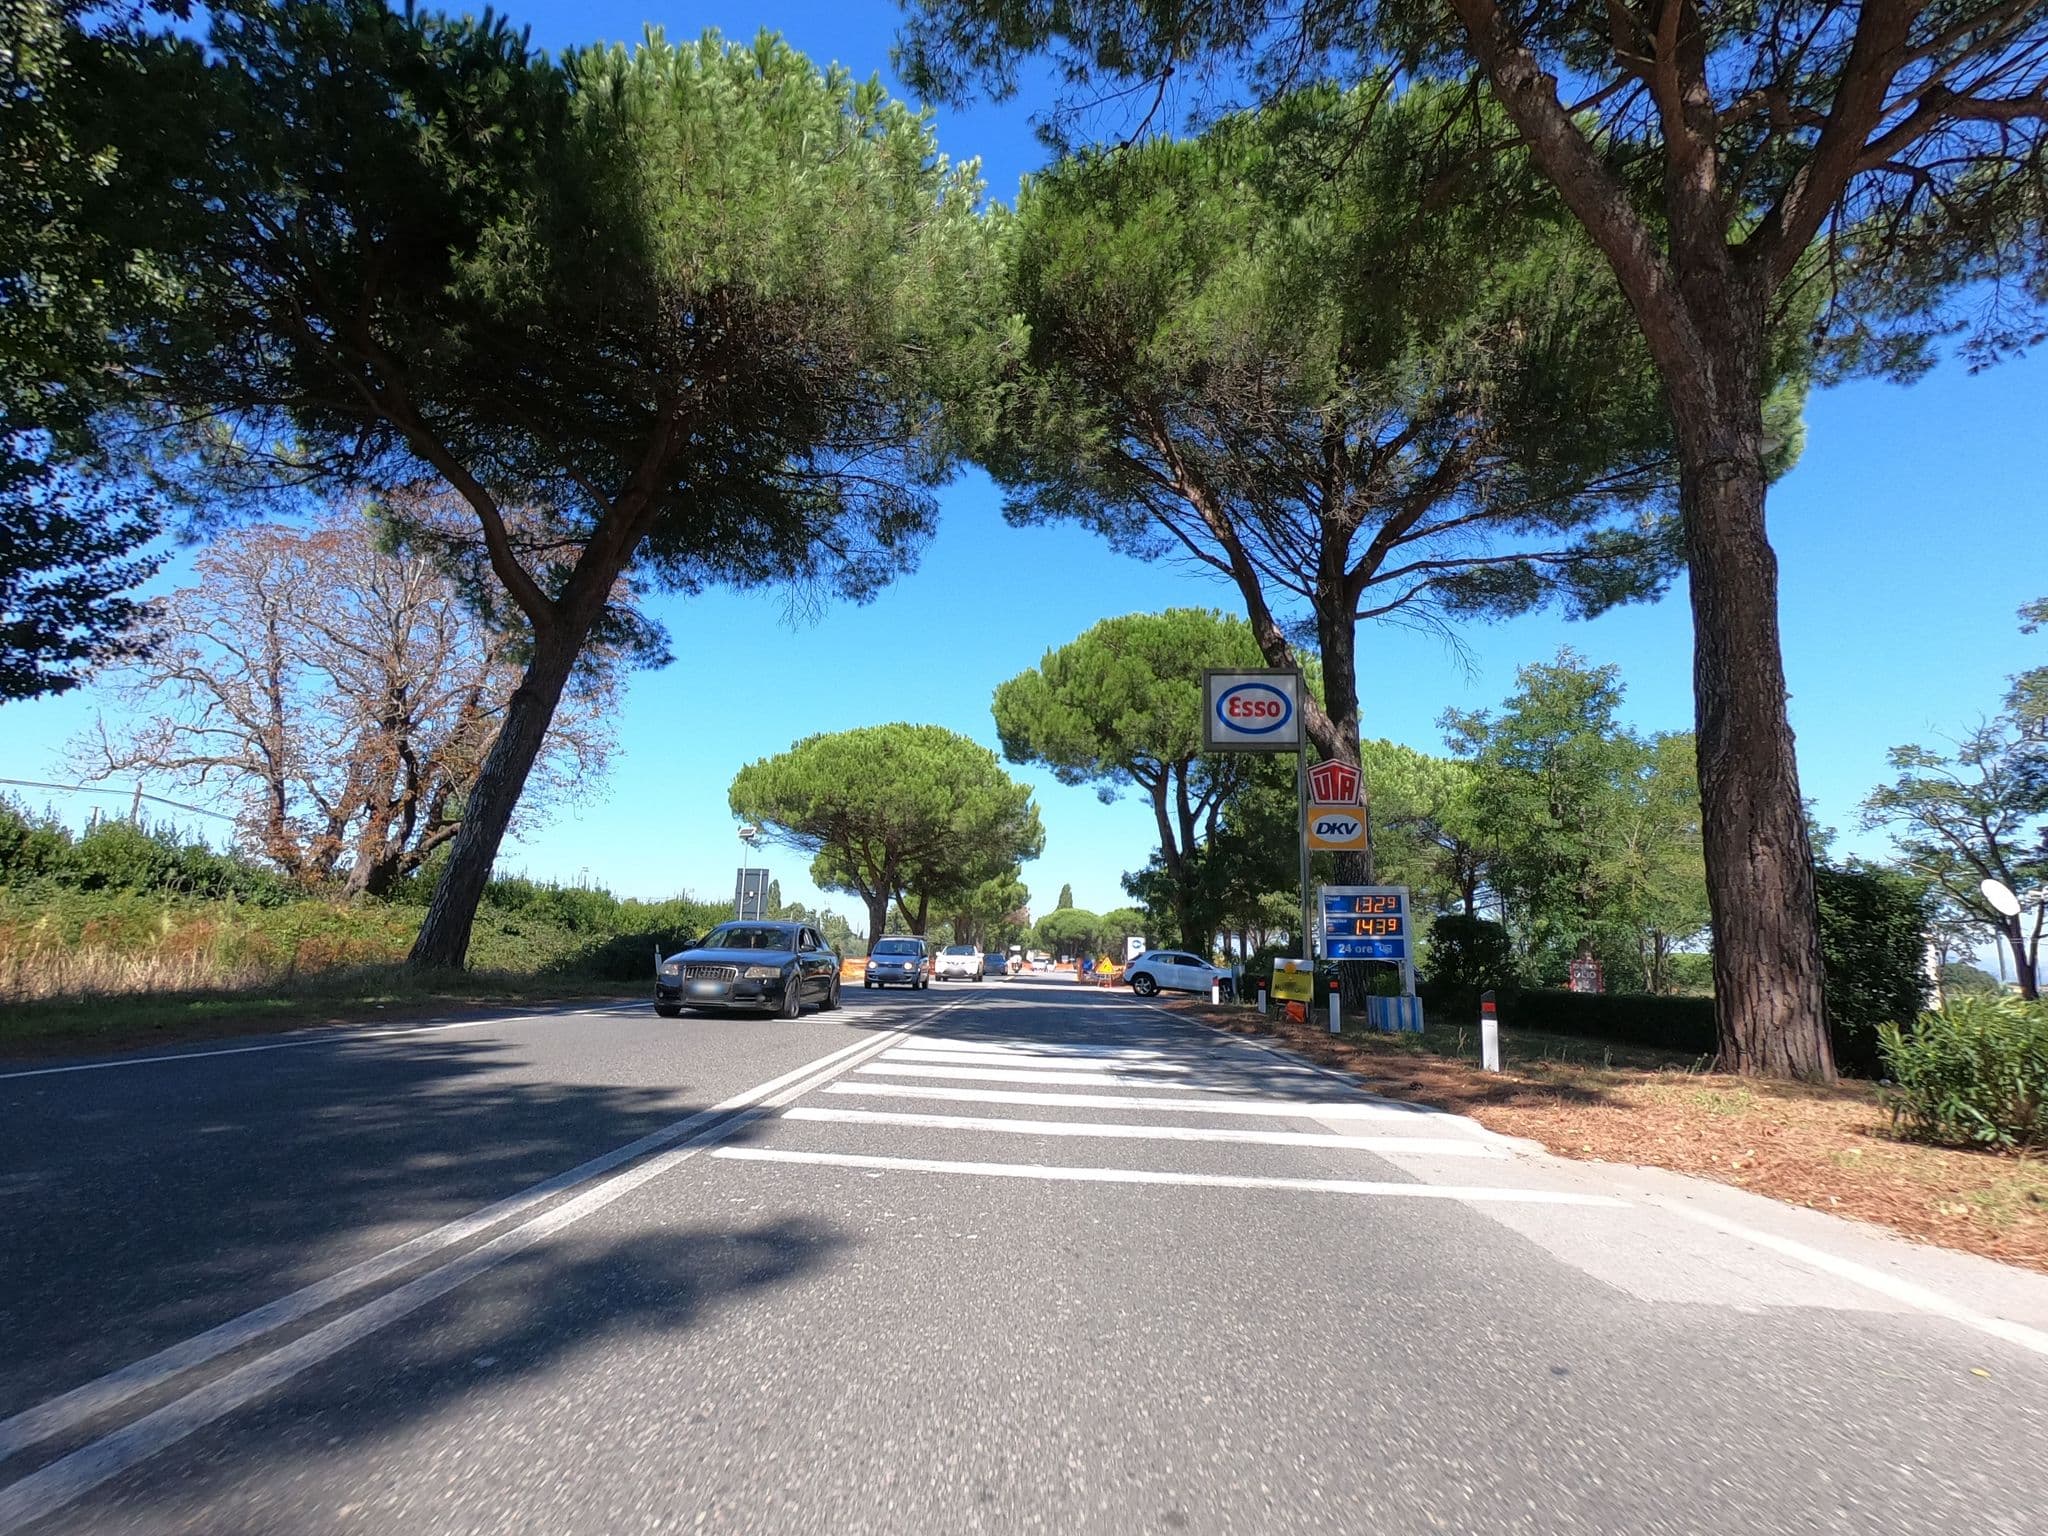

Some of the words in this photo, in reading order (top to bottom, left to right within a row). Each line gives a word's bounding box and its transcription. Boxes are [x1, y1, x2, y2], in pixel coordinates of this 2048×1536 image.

[1228, 696, 1281, 717] Esso
[1311, 763, 1357, 800] UTA
[1316, 822, 1358, 835] DKV
[1338, 943, 1352, 954] 24
[1355, 945, 1373, 954] ore
